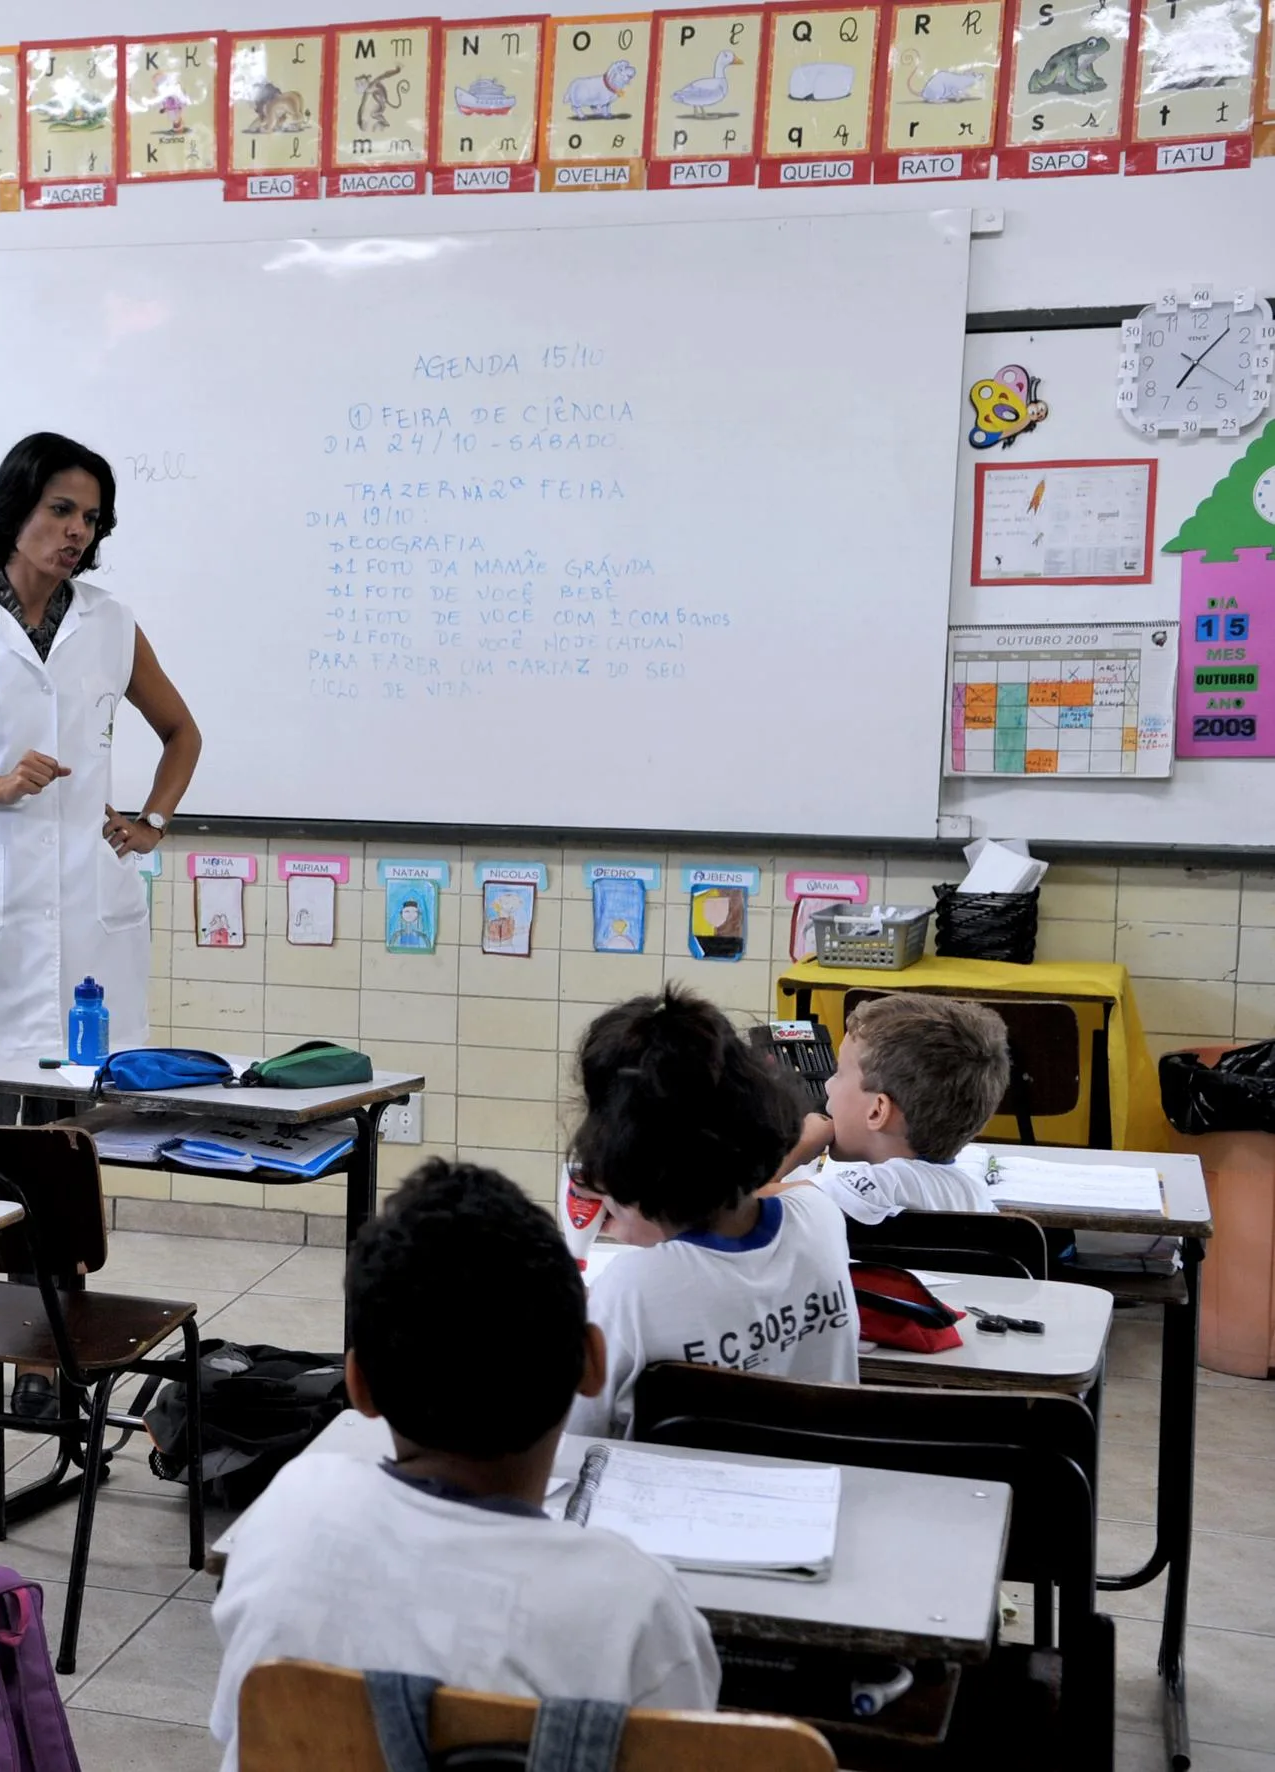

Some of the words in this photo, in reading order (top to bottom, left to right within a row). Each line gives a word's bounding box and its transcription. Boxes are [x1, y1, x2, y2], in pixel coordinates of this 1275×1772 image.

[1039, 4, 1053, 25] S
[792, 21, 812, 42] Q
[914, 14, 930, 34] R
[573, 31, 590, 51] O
[681, 26, 695, 46] P
[355, 39, 375, 58] M
[462, 36, 479, 55] N
[1030, 153, 1087, 171] SAPO
[1161, 146, 1214, 166] TATU
[557, 166, 628, 184] OVELHA
[673, 162, 722, 179] PATO
[783, 163, 853, 180] QUEIJO
[901, 157, 955, 175] RATO
[249, 177, 293, 196] LEÃO
[342, 174, 414, 193] MACACO
[456, 169, 509, 187] NAVIO
[1162, 295, 1176, 306] 55
[1194, 290, 1209, 302] 60
[1126, 326, 1140, 337] 50
[1261, 327, 1275, 338] 10
[413, 354, 520, 381] AGENDA
[542, 345, 604, 369] 15/10
[1120, 359, 1135, 370] 45
[1255, 356, 1269, 368] 15
[1119, 391, 1133, 401] 40
[1252, 389, 1267, 400] 20
[381, 406, 453, 428] FEIRA
[469, 405, 507, 425] DE
[522, 396, 635, 425] CIÊNCIA
[1141, 423, 1155, 434] 35
[1182, 421, 1197, 432] 30
[1221, 418, 1236, 430] 25
[324, 435, 367, 455] DIA
[125, 450, 197, 483] Bell
[344, 480, 455, 502] TRAZER
[462, 484, 484, 502] NA
[540, 479, 626, 501] FEIRA
[306, 510, 348, 528] DIA
[348, 534, 486, 555] ECOGRAFIA
[366, 558, 414, 576] FOTO
[427, 559, 459, 577] DA
[565, 553, 656, 579] GRÁVIDA
[366, 585, 414, 600] FOTO
[430, 585, 460, 603] DE
[476, 580, 535, 601] VOCÊ
[559, 578, 620, 601] BEBÊ
[1207, 597, 1238, 610] DIA
[366, 608, 412, 624] FOTO
[431, 611, 462, 626] DE
[478, 599, 534, 625] VOCÊ
[553, 609, 596, 628] COM
[628, 609, 670, 627] COM
[690, 612, 731, 628] anos
[367, 630, 413, 649] FOTO
[433, 631, 463, 647] DE
[996, 635, 1062, 647] OUTUBRO
[1066, 635, 1099, 646] 2009
[309, 648, 358, 670] PARA
[372, 652, 441, 676] FAZER
[1206, 647, 1246, 661] MES
[1196, 673, 1255, 685] OUTUBRO
[1206, 697, 1245, 710] ANO
[1194, 718, 1256, 737] 2009
[292, 863, 329, 873] MIRIAM
[392, 868, 429, 878] NATAN
[593, 867, 637, 879] PEDRO
[693, 871, 743, 883] RUBENS
[748, 1305, 797, 1351] 305
[804, 1280, 848, 1323] Sul
